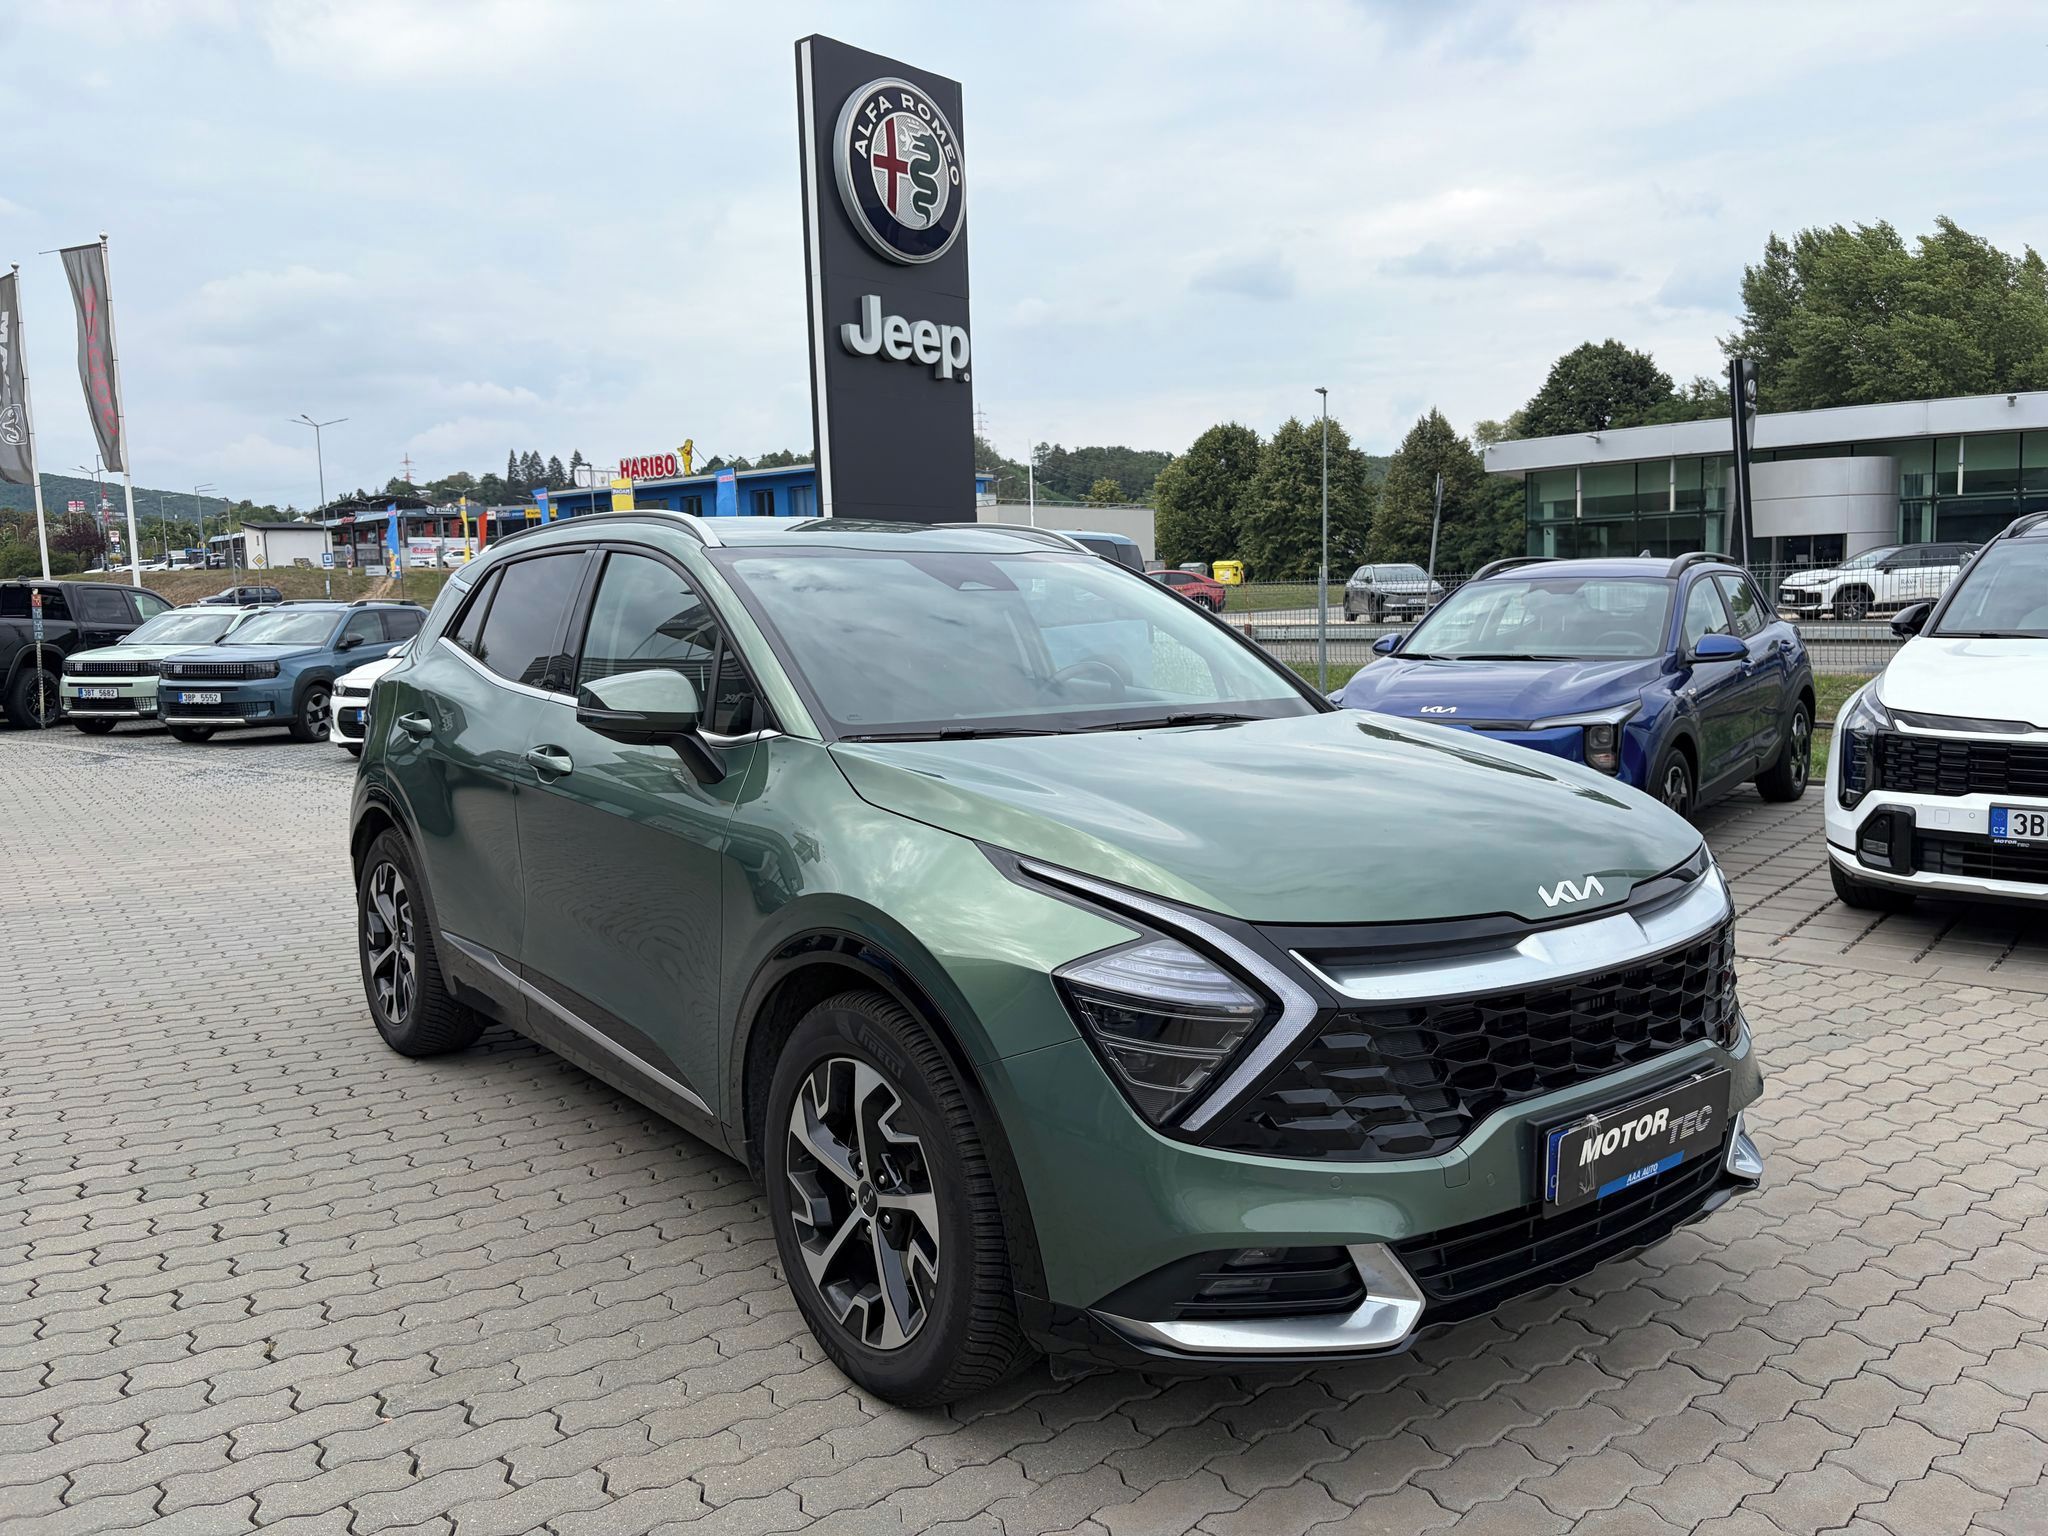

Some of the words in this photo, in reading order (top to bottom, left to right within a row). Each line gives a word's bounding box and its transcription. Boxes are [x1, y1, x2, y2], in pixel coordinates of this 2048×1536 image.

[854, 94, 893, 160] ALFA
[900, 93, 960, 187] ROMEO
[840, 294, 970, 380] Jeep
[619, 453, 677, 479] HARIBO
[200, 693, 218, 702] 5552
[1993, 826, 2006, 834] CZ
[2013, 813, 2048, 838] 3B
[1537, 875, 1605, 908] KIA
[1578, 1107, 1670, 1168] MOTOR
[1668, 1104, 1714, 1145] TEC
[1626, 1169, 1641, 1184] AAA
[1641, 1162, 1659, 1178] AUTO
